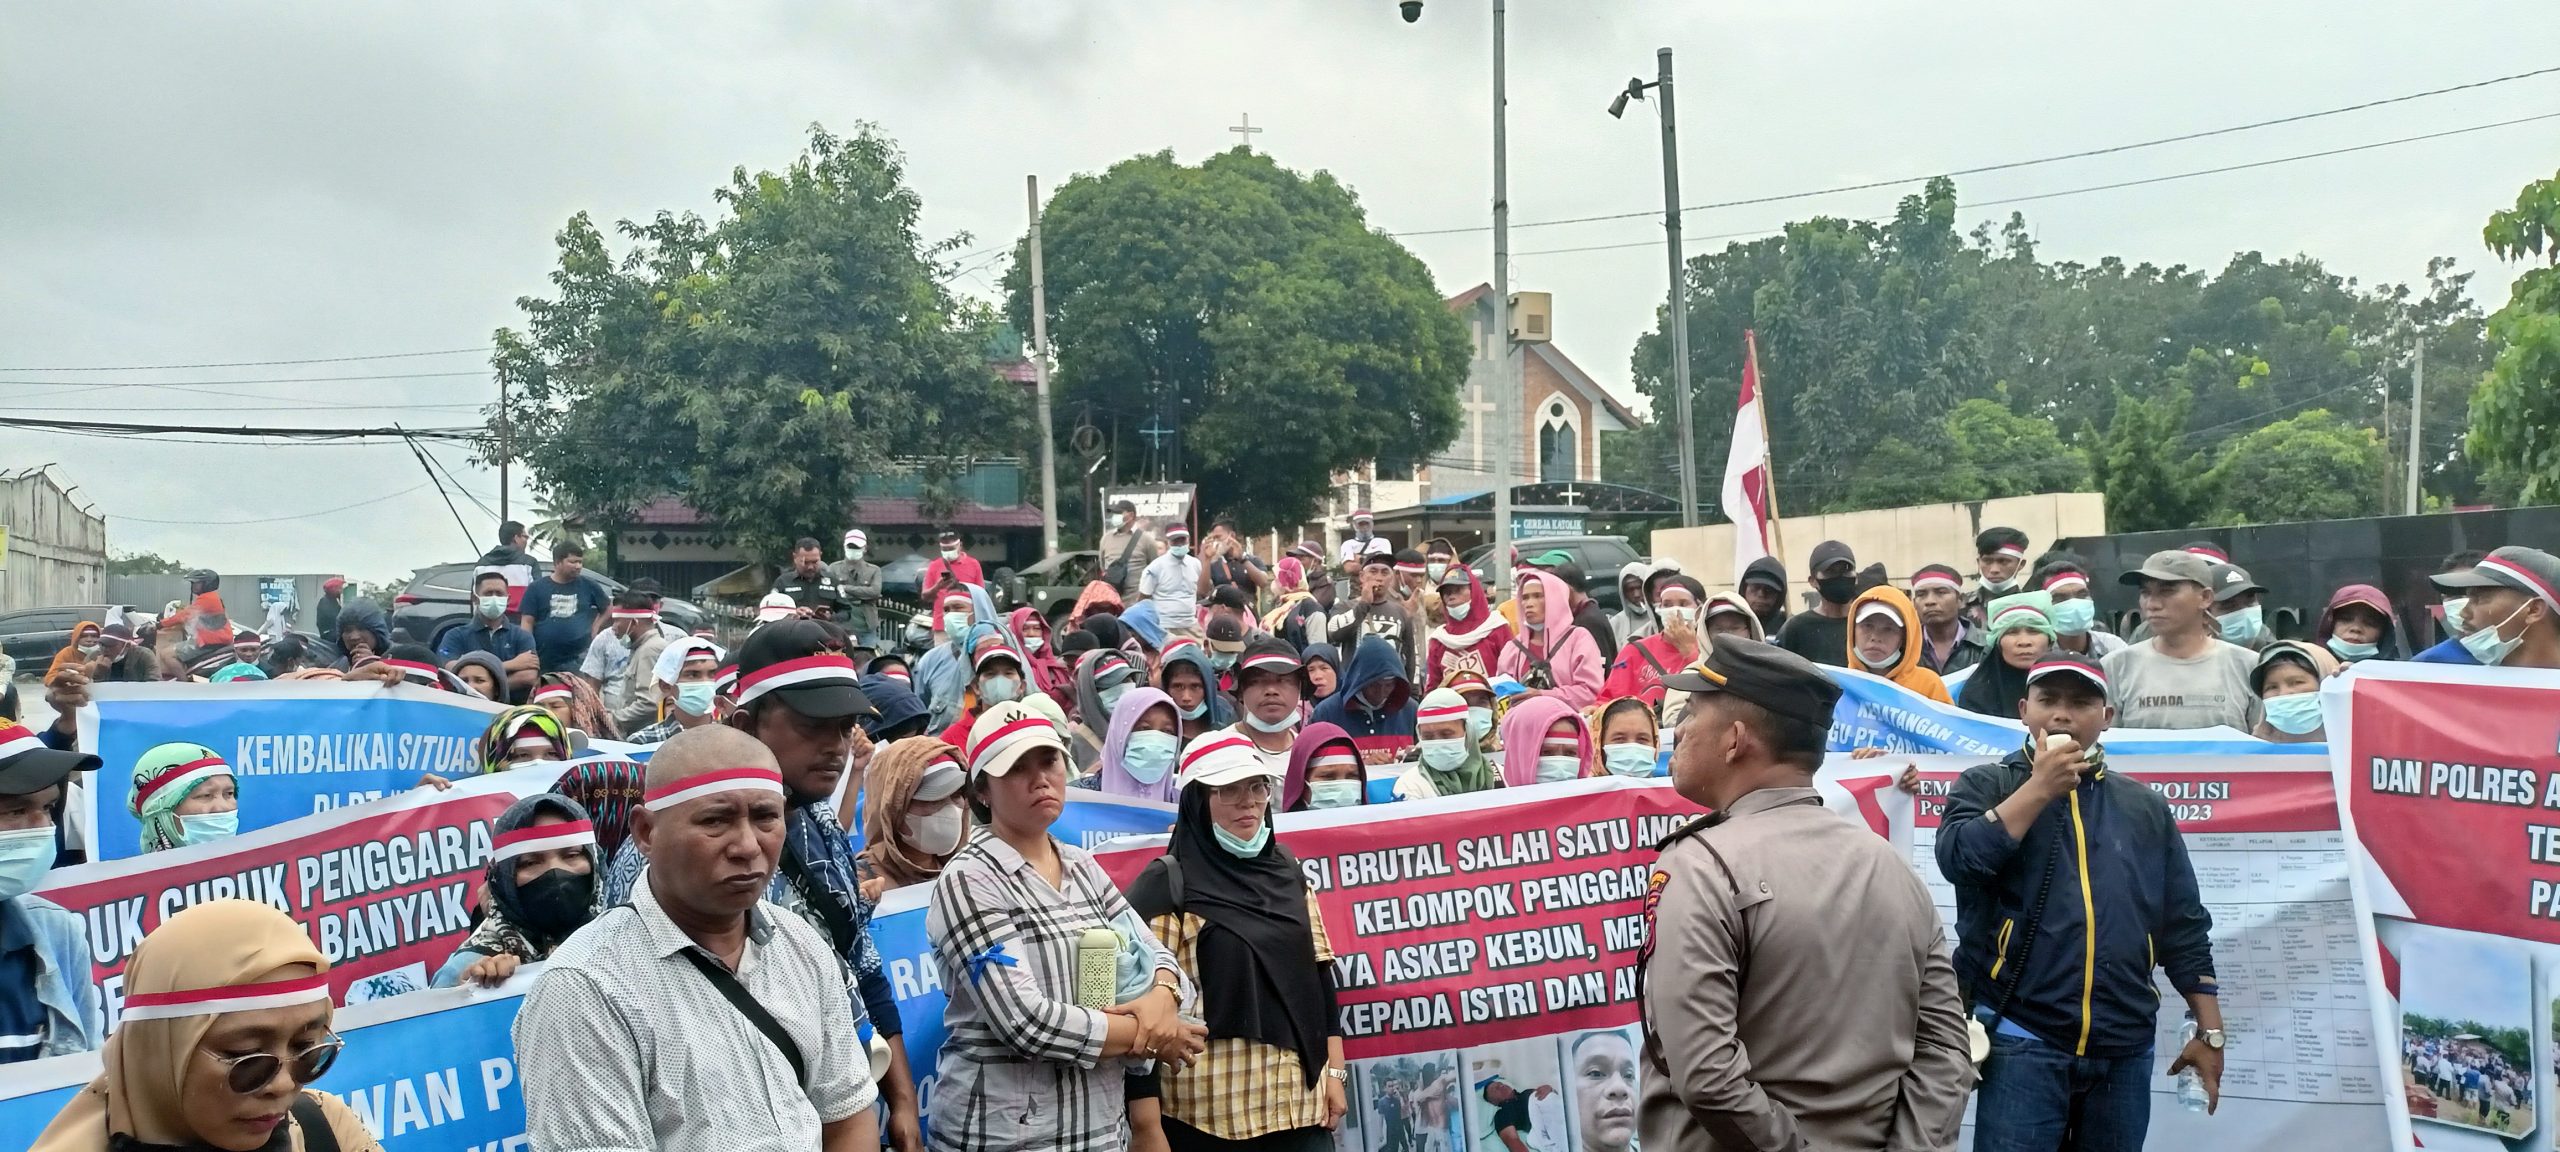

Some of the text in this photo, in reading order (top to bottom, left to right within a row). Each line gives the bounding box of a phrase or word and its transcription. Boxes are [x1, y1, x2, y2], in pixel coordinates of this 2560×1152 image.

[1523, 518, 1582, 530] GEREJA KATOLIK
[2138, 695, 2184, 708] NEVADA
[236, 732, 484, 776] KEMBALIKAN SITUAS
[2372, 757, 2422, 794] DAN
[2430, 763, 2536, 805] POLRES
[2150, 782, 2230, 799] POLISI
[298, 821, 497, 908] PENGGARA
[1339, 843, 1451, 887] BRUTAL
[1457, 830, 1549, 872] SALAH
[1556, 816, 1631, 859] SATU
[320, 882, 471, 964] BANYAK
[1353, 863, 1656, 936] KELOMPOK PENGGAR
[1331, 953, 1375, 989] YA
[1384, 939, 1476, 982] ASKEP
[1485, 923, 1597, 968] KEBUN,
[1339, 995, 1453, 1036] KEPADA
[1462, 981, 1537, 1023] ISTRI
[1543, 973, 1606, 1012] DAN
